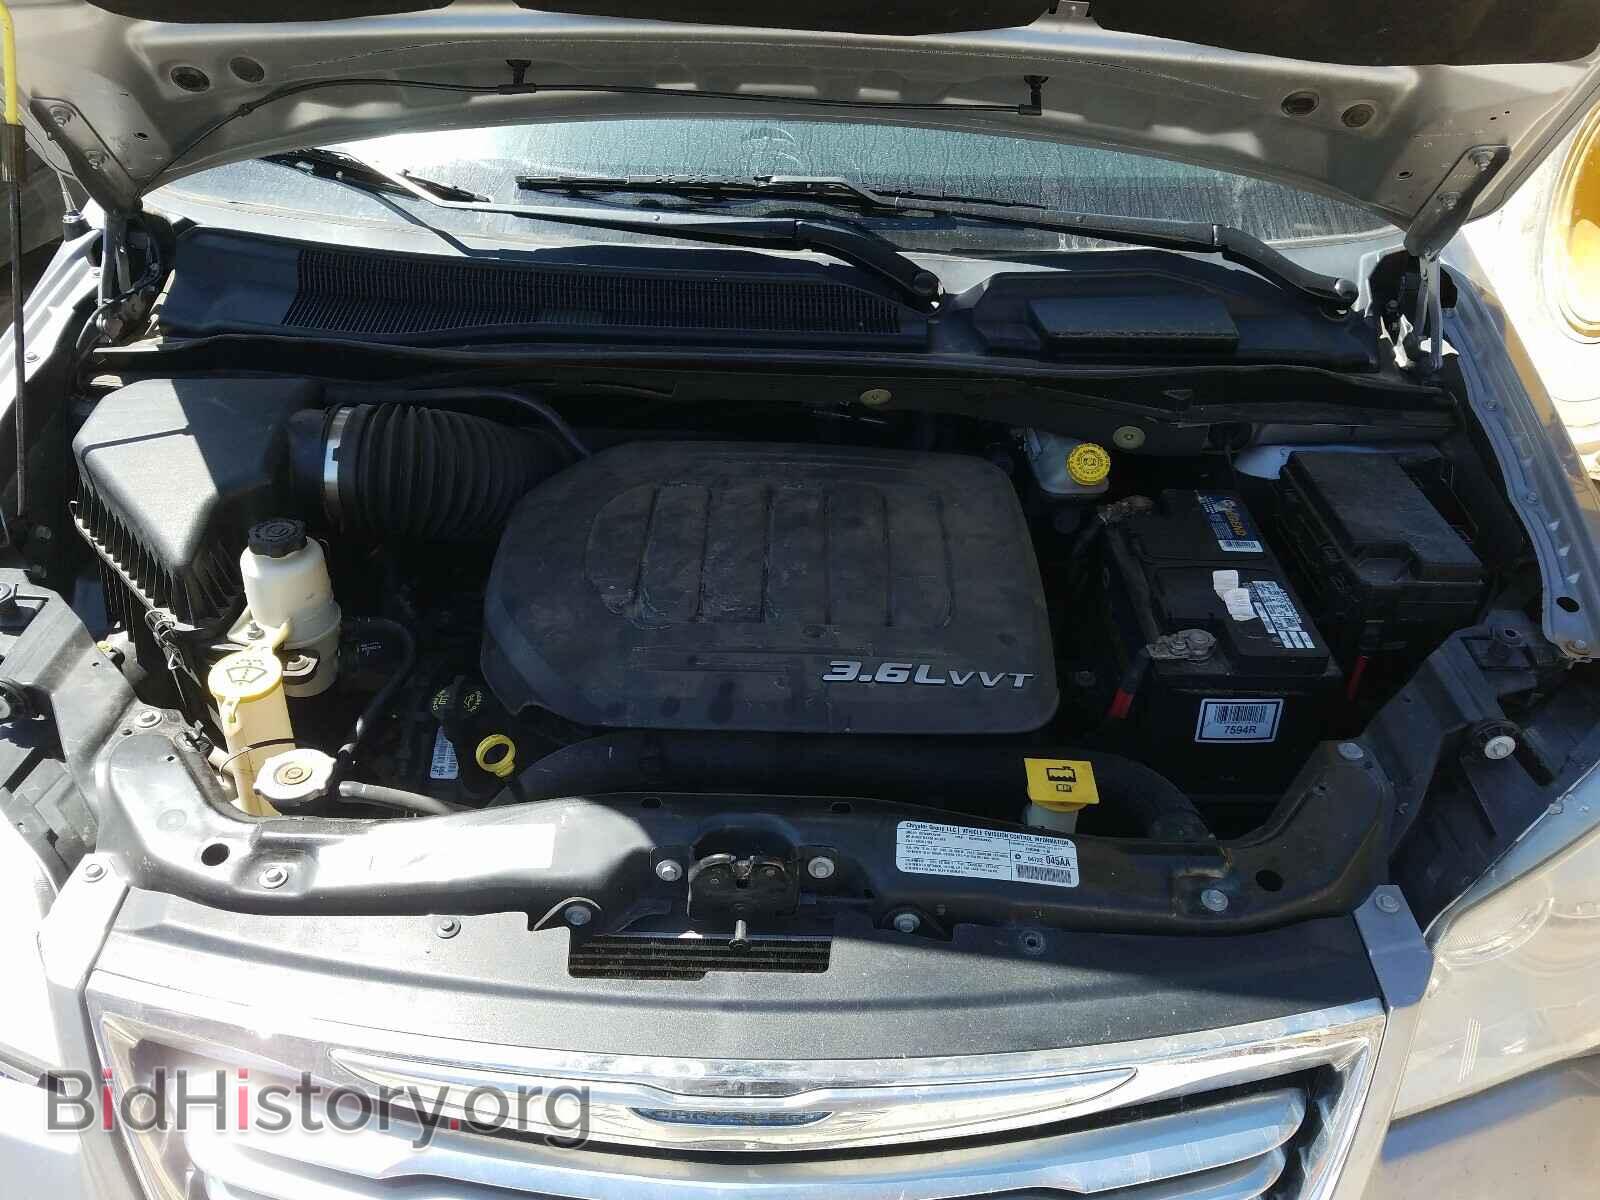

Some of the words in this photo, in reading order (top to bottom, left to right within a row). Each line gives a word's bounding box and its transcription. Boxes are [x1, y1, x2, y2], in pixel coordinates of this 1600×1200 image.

[822, 660, 946, 684] 3.6L
[948, 670, 1034, 688] VVT
[1223, 725, 1257, 735] 7594R
[946, 825, 957, 833] LLC
[962, 828, 983, 836] VEHICLE
[984, 830, 1009, 839] EMISSION
[1009, 833, 1033, 842] CONTROL
[1034, 836, 1069, 846] INFORMATION
[1045, 855, 1071, 867] 045AA
